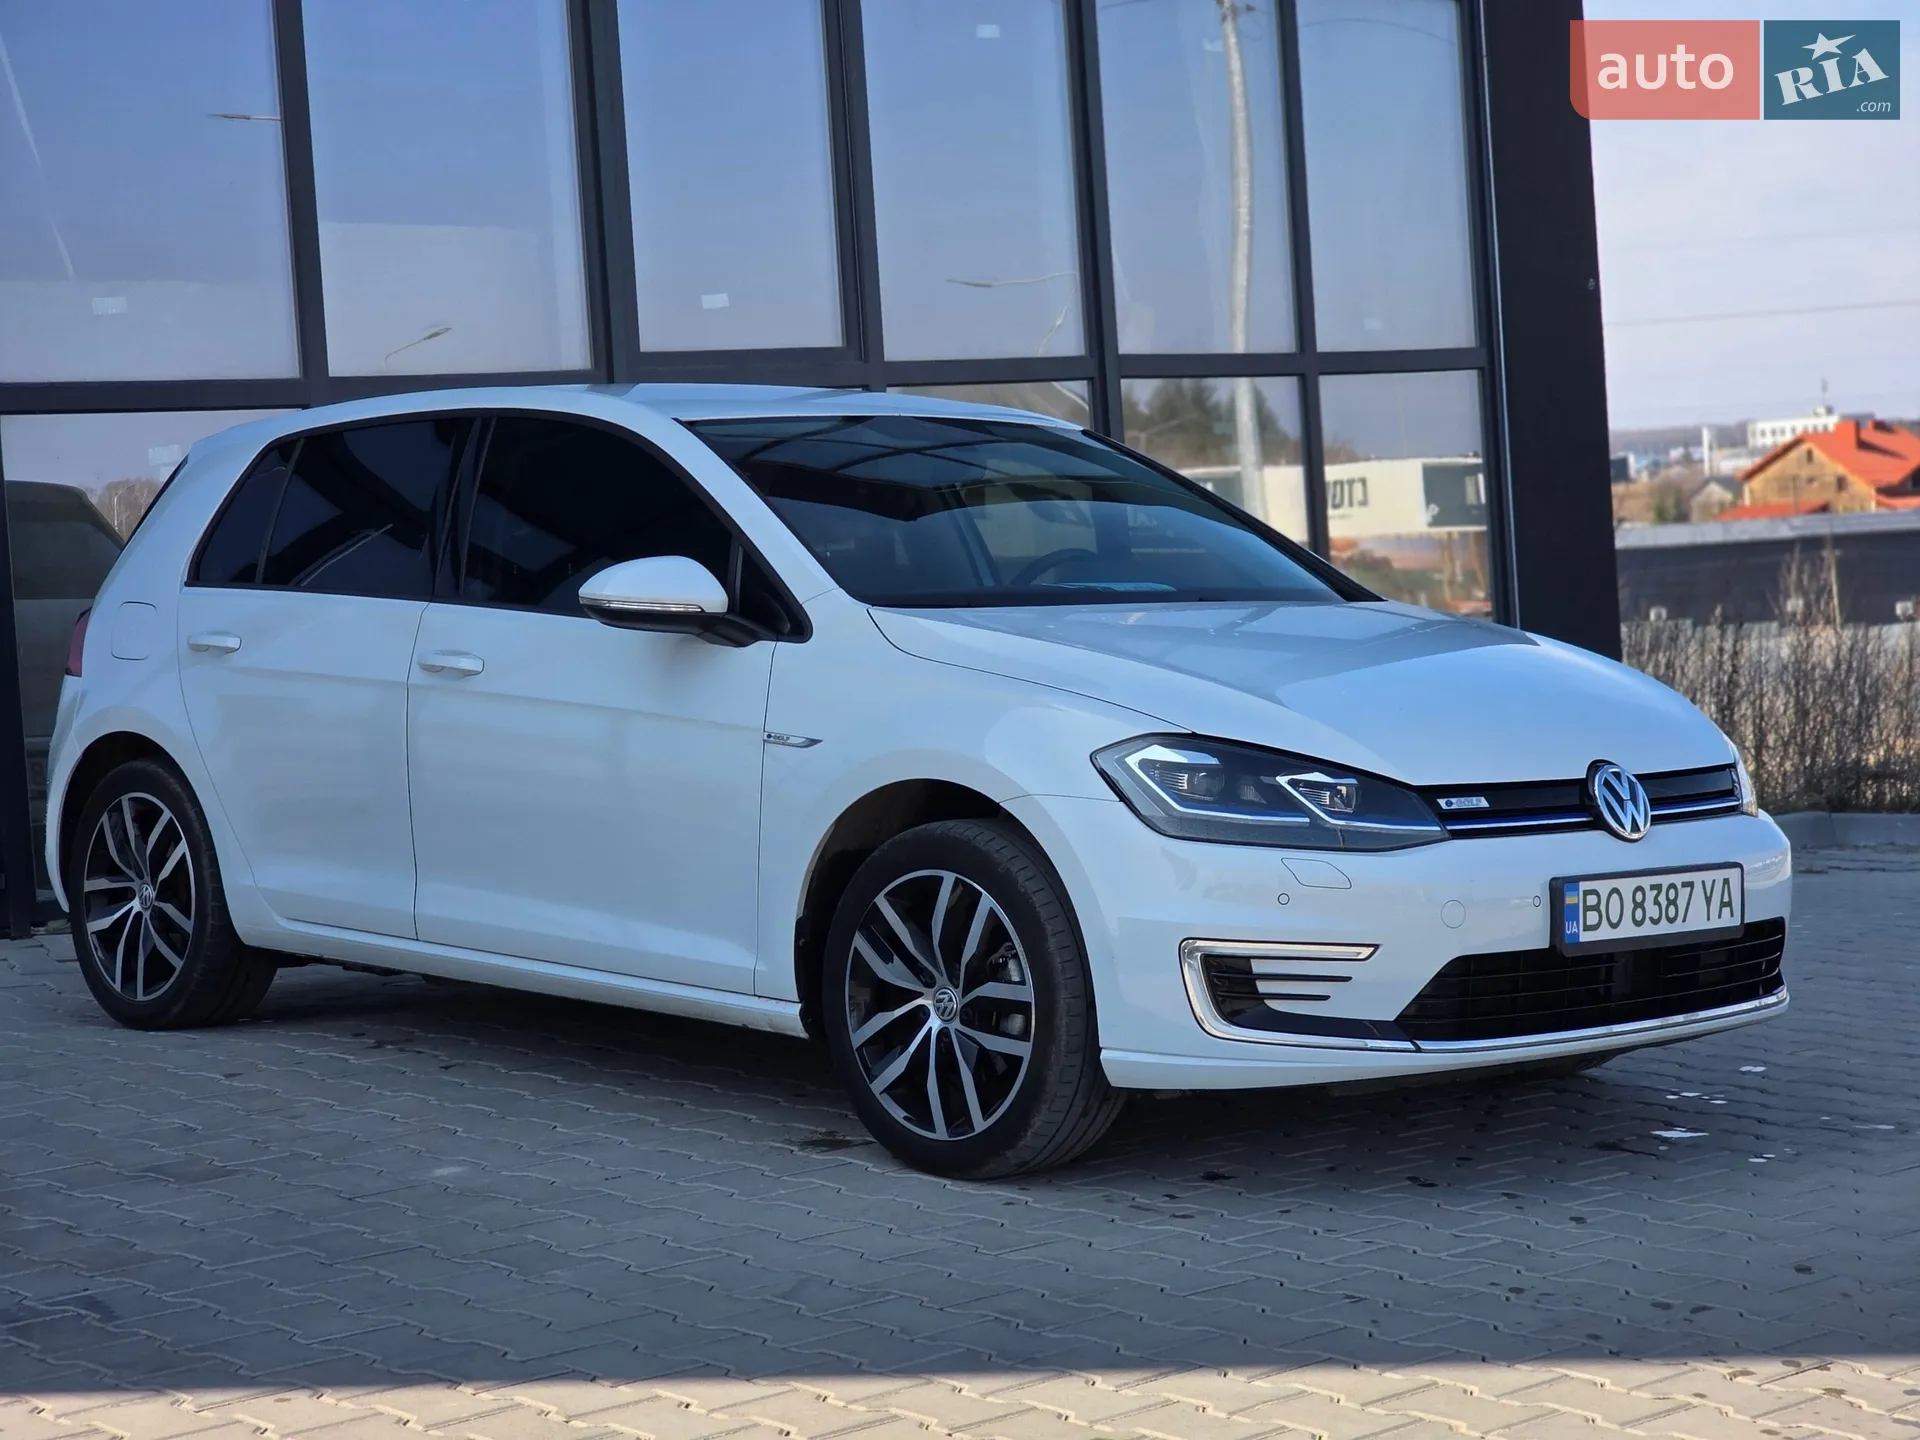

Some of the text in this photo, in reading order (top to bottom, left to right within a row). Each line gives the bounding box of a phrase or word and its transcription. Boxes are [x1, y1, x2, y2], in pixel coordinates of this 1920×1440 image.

[1582, 877, 1735, 932] BO 8387 YA
[1565, 921, 1579, 935] UA
